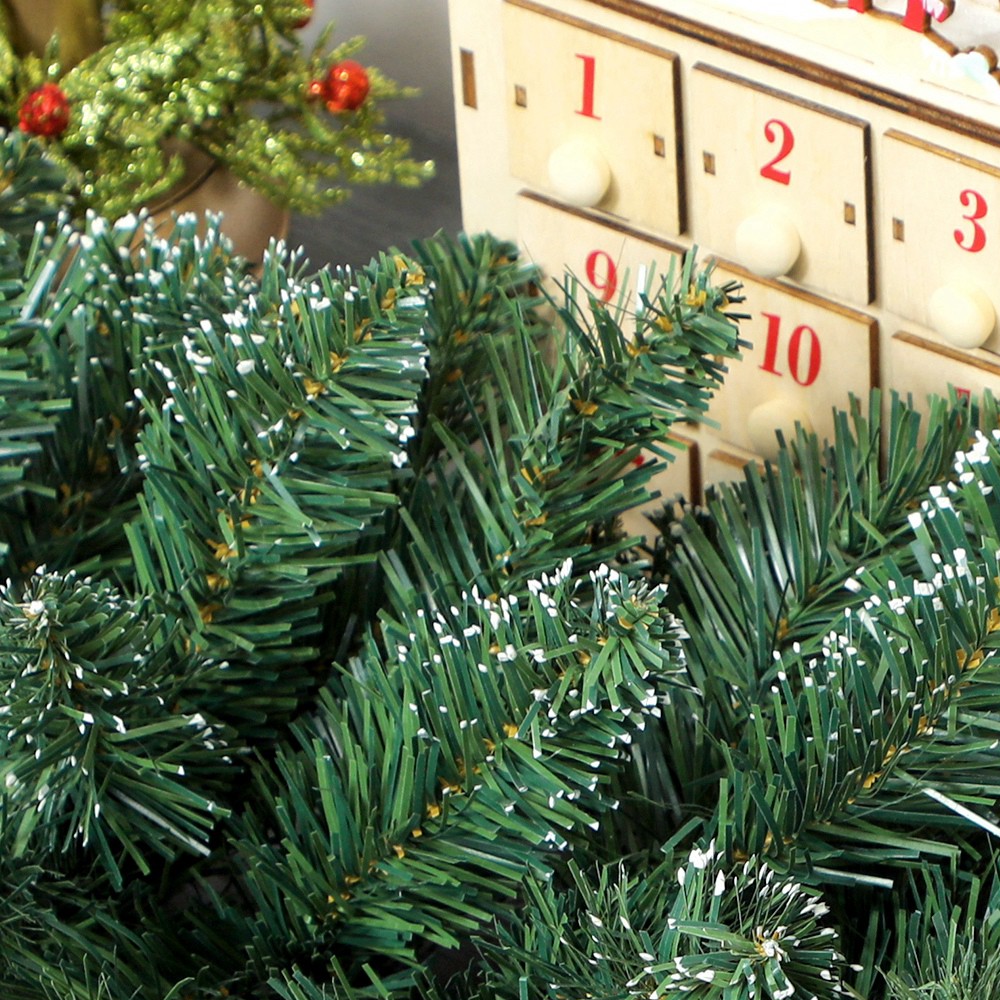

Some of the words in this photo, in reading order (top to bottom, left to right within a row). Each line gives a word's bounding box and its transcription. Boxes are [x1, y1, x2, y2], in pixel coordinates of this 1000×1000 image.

[573, 53, 603, 121] 1
[759, 118, 796, 187] 2
[952, 188, 989, 254] 3
[585, 249, 618, 306] 9
[757, 311, 823, 388] 10
